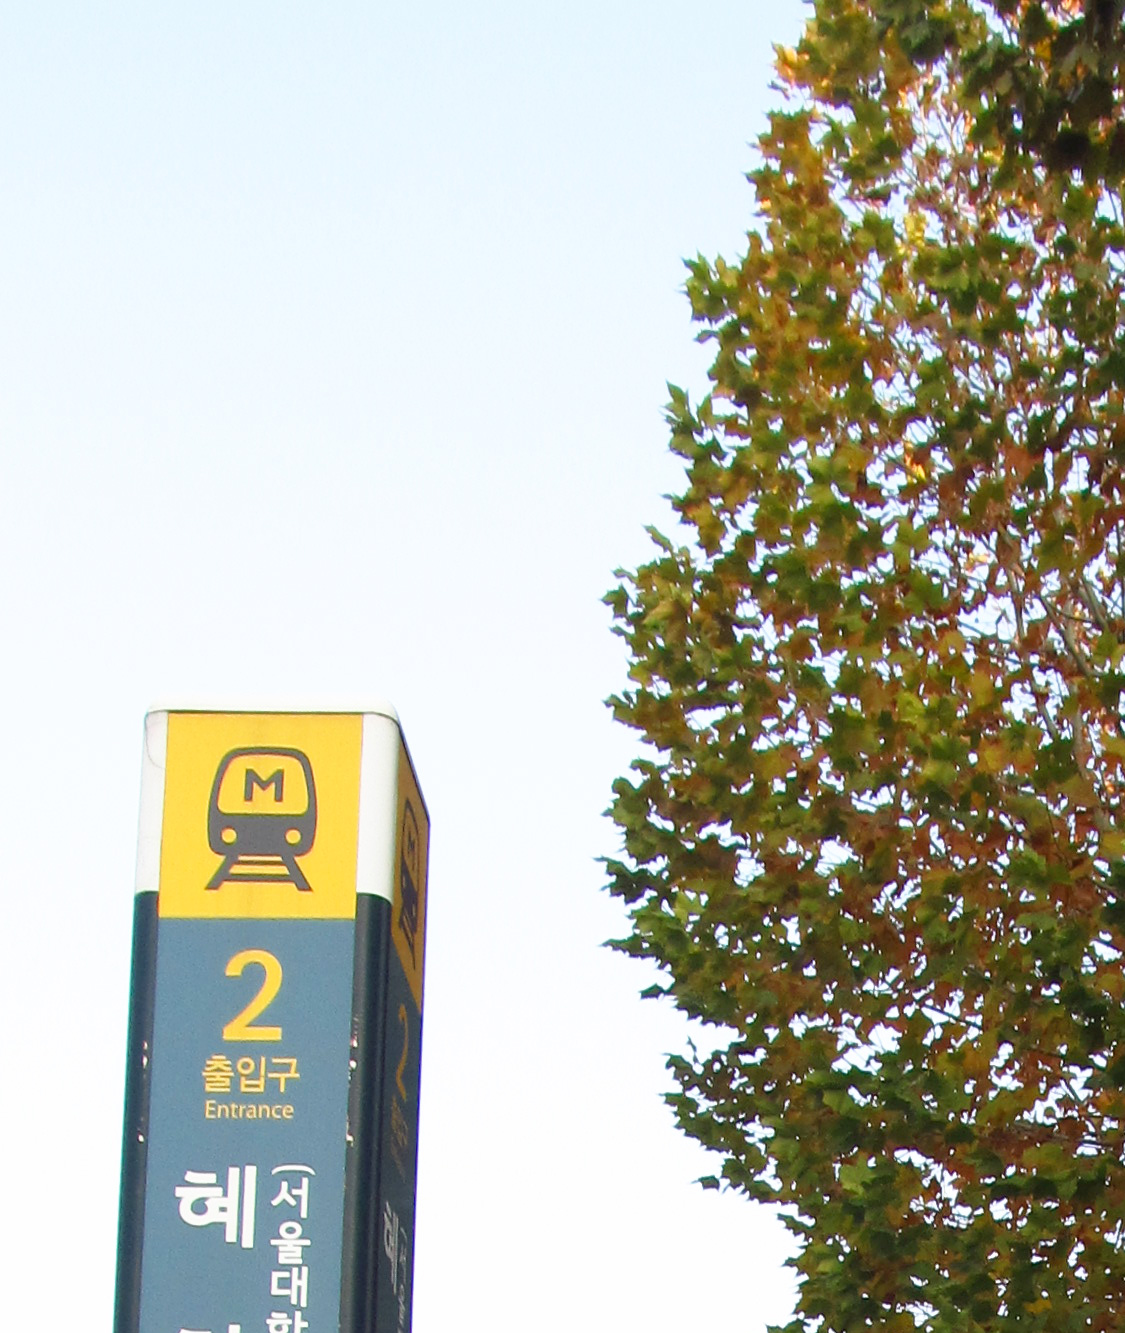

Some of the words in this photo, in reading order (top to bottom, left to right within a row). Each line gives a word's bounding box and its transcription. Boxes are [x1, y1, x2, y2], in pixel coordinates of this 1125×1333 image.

[244, 768, 284, 802] M
[222, 948, 284, 1042] 2
[201, 1054, 300, 1093] 출입구
[204, 1099, 295, 1120] Entrance
